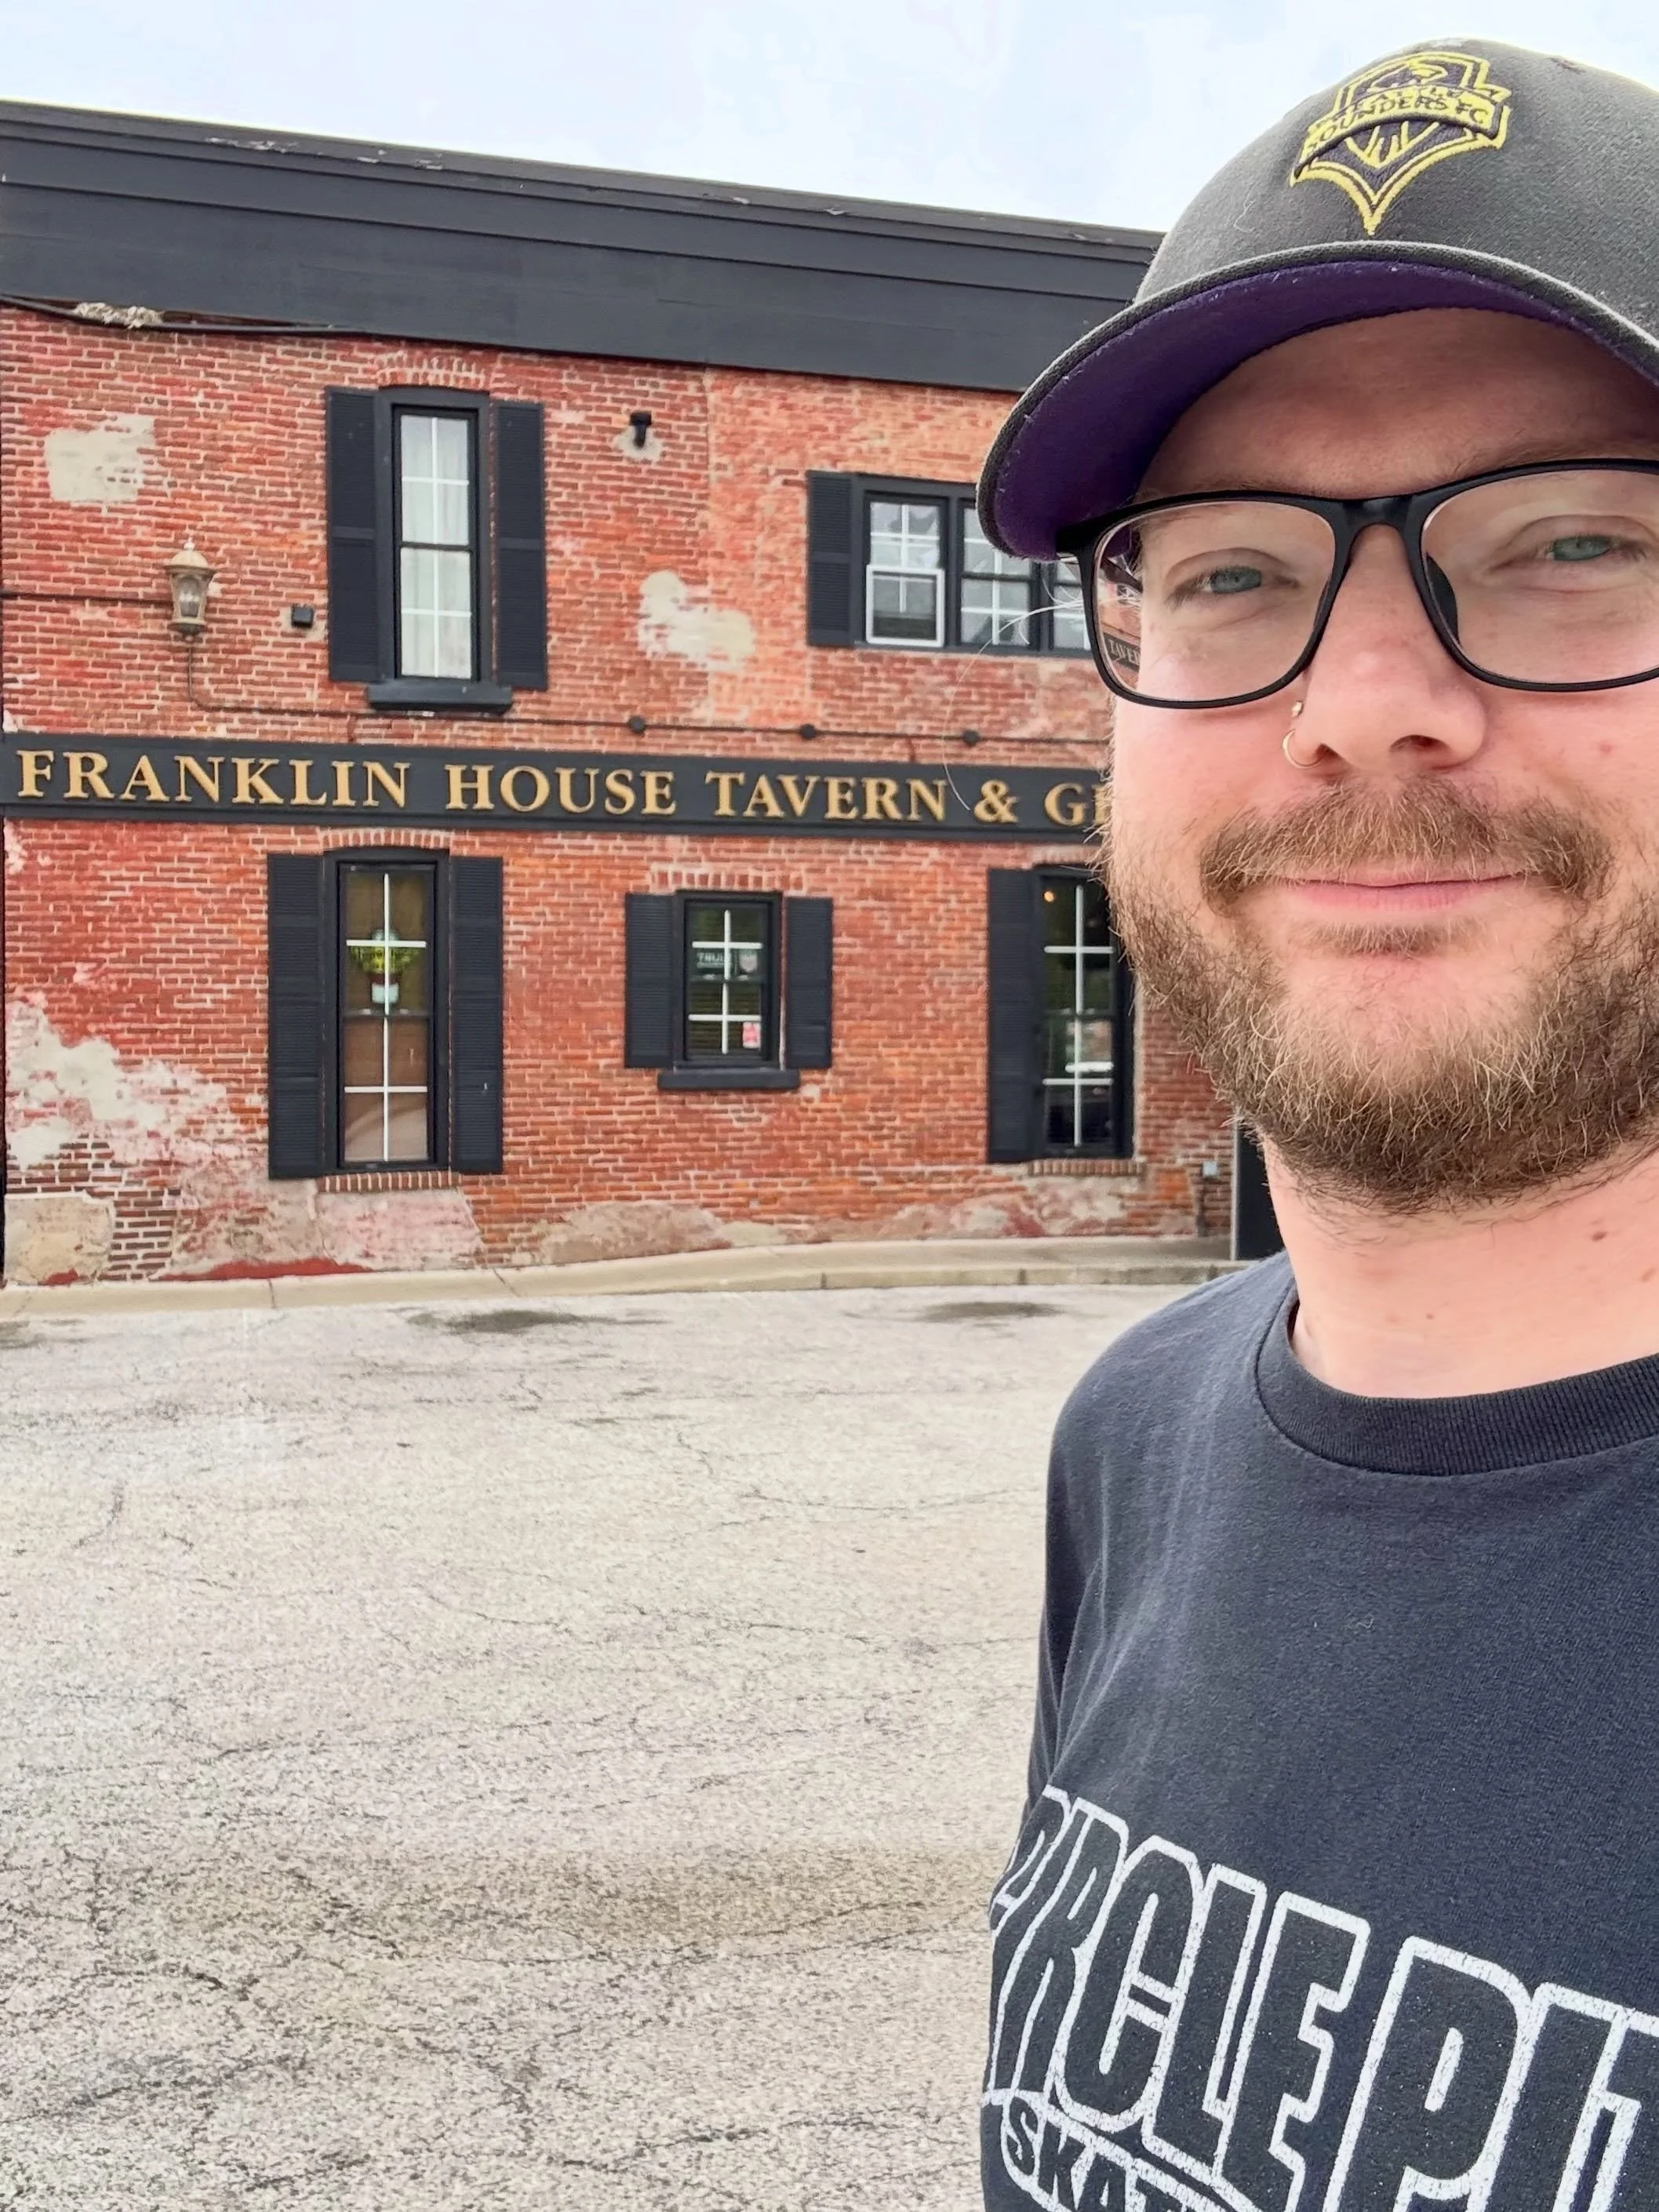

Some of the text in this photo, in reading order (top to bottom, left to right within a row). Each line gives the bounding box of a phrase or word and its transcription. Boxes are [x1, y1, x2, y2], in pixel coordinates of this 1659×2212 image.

[1455, 98, 1489, 125] FC
[16, 748, 411, 809] FRANKLIN
[444, 763, 677, 816] HOUSE
[705, 769, 947, 821] TAVERN
[973, 778, 1018, 824] &
[1009, 2095, 1197, 2212] SKAT
